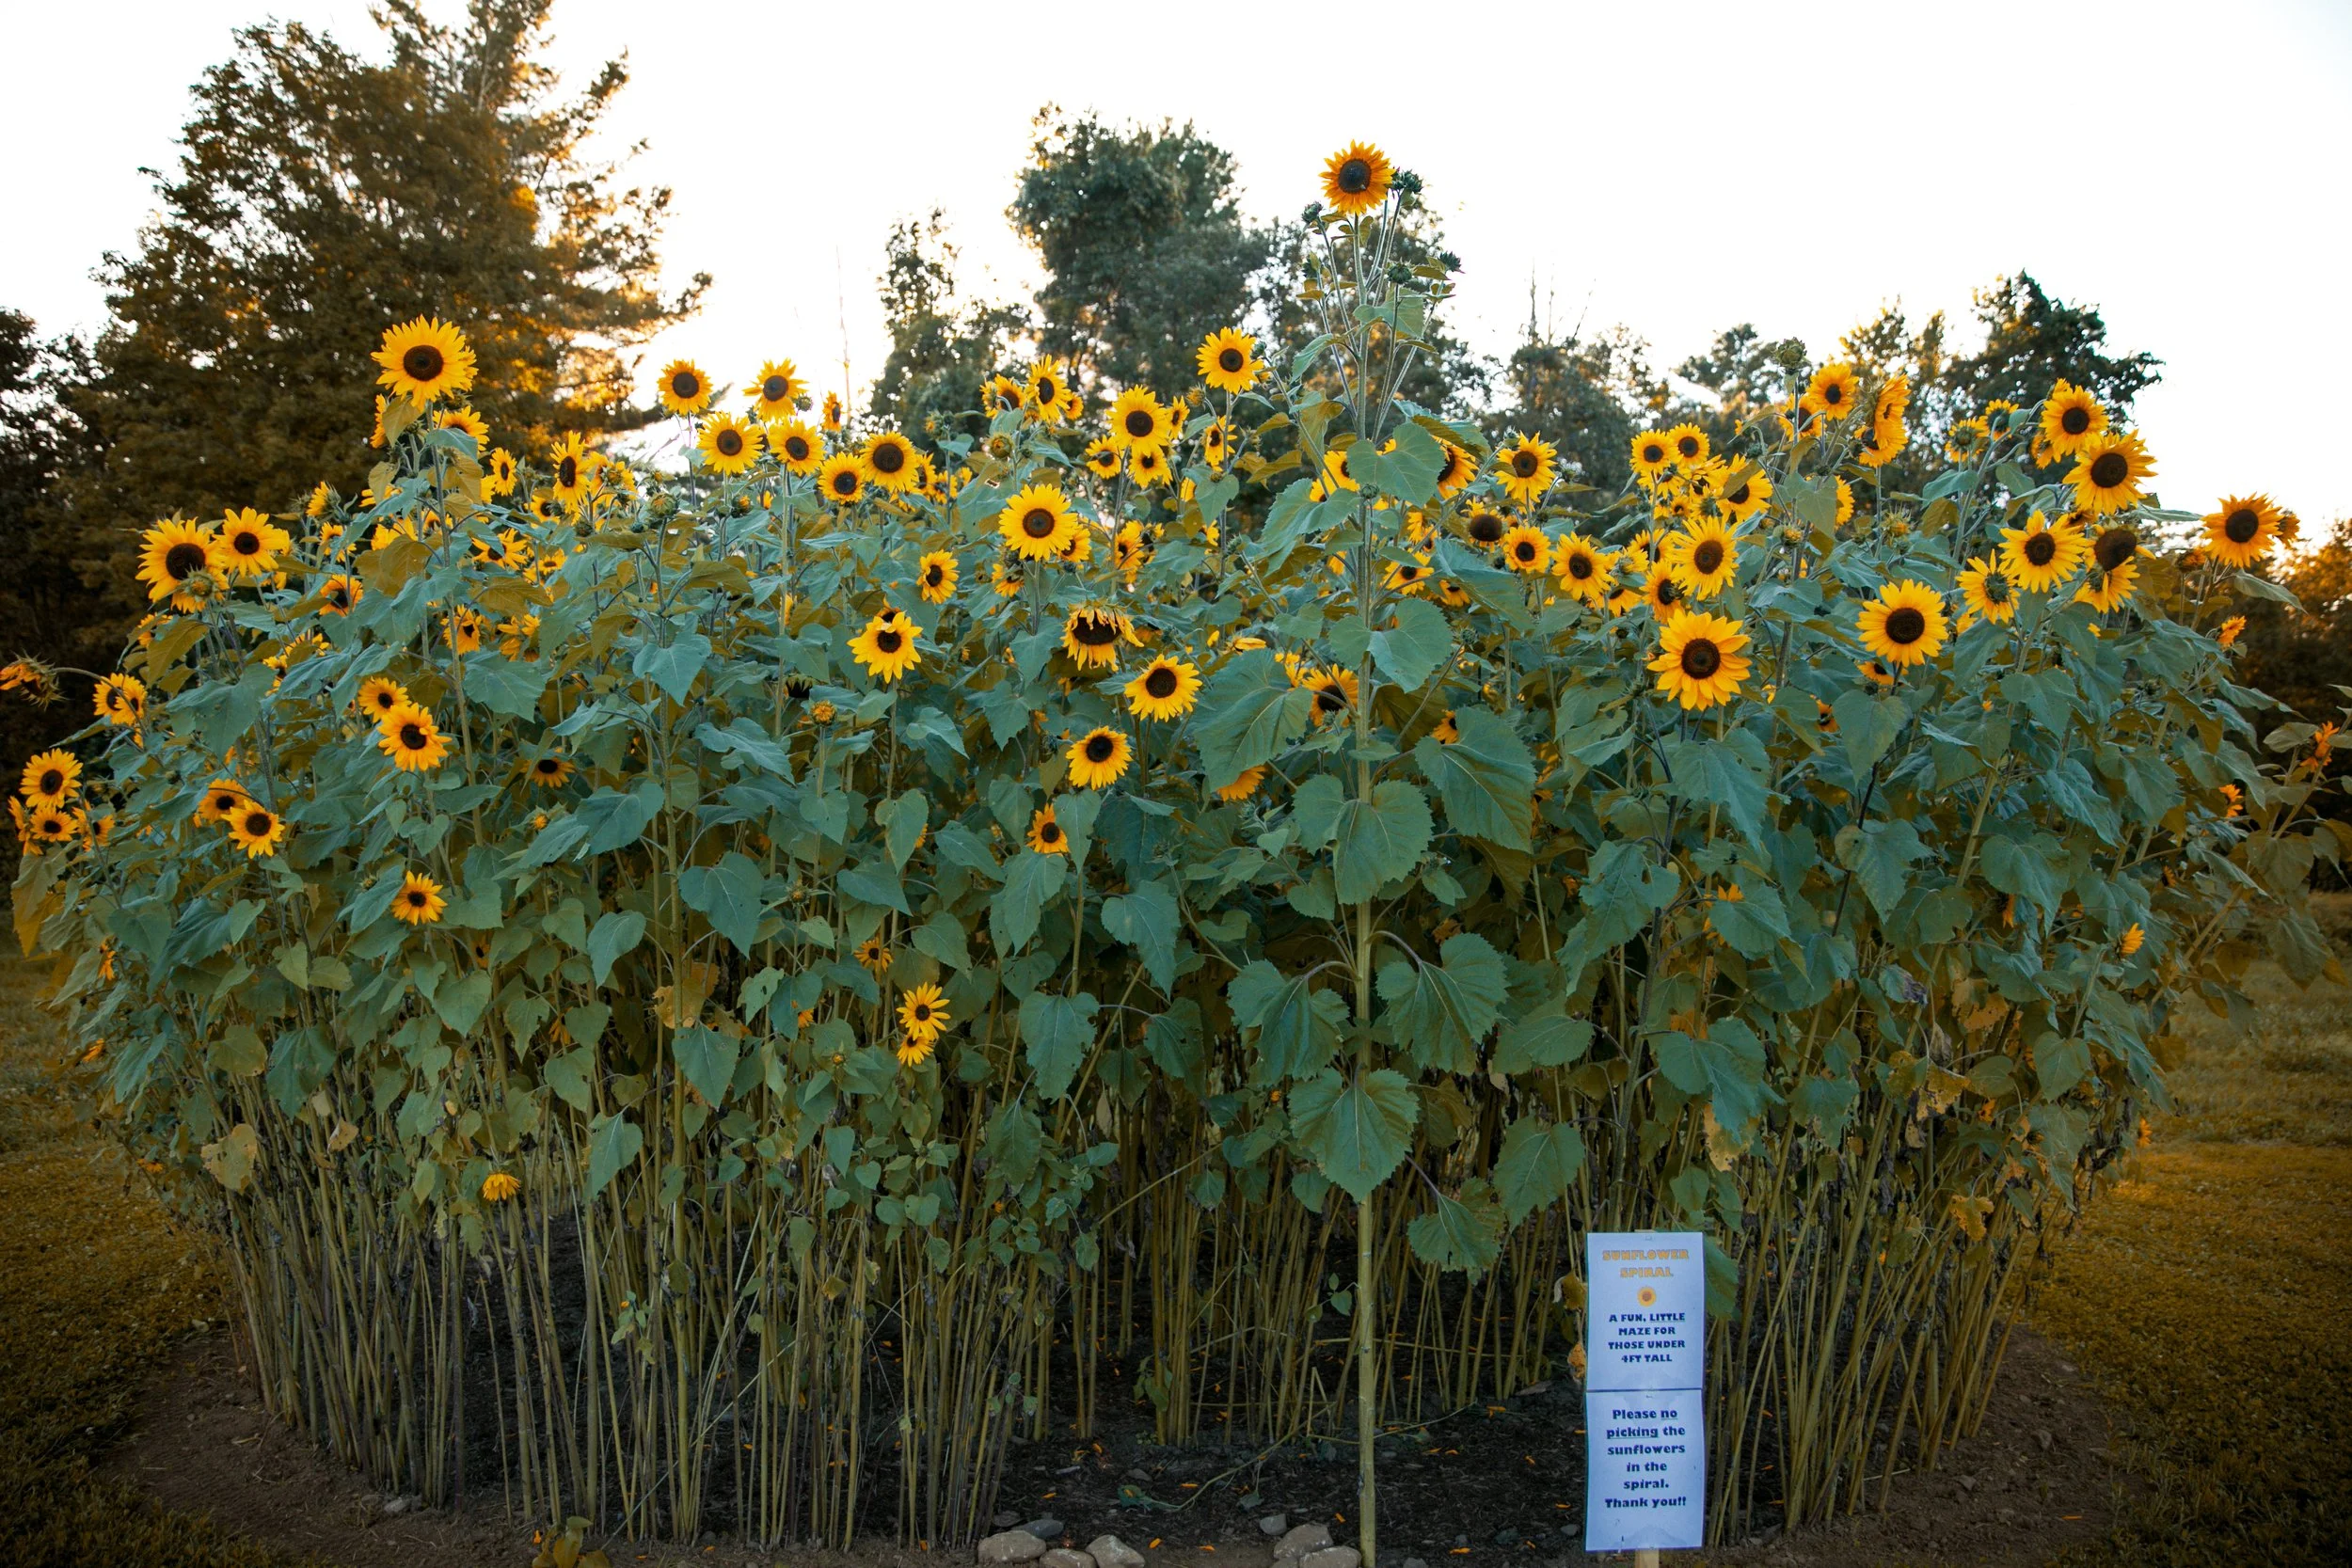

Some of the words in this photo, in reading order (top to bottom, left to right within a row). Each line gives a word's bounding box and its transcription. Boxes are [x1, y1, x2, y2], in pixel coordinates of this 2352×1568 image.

[1602, 1249, 1689, 1260] SUNFLOWER
[1620, 1267, 1674, 1278] SPIRAL
[1621, 1314, 1646, 1323] FUN,
[1650, 1313, 1685, 1322] LITTLE
[1654, 1326, 1676, 1335] FOR
[1608, 1341, 1644, 1350] THOSE
[1613, 1410, 1657, 1419] Please
[1661, 1410, 1677, 1418] no
[1606, 1427, 1659, 1438] picking
[1662, 1426, 1685, 1435] the
[1607, 1444, 1686, 1455] sunflowers
[1627, 1463, 1640, 1472] in
[1645, 1462, 1667, 1471] the
[1624, 1480, 1669, 1491] spiral.
[1605, 1497, 1648, 1508] Thank
[1652, 1497, 1686, 1508] you!!
